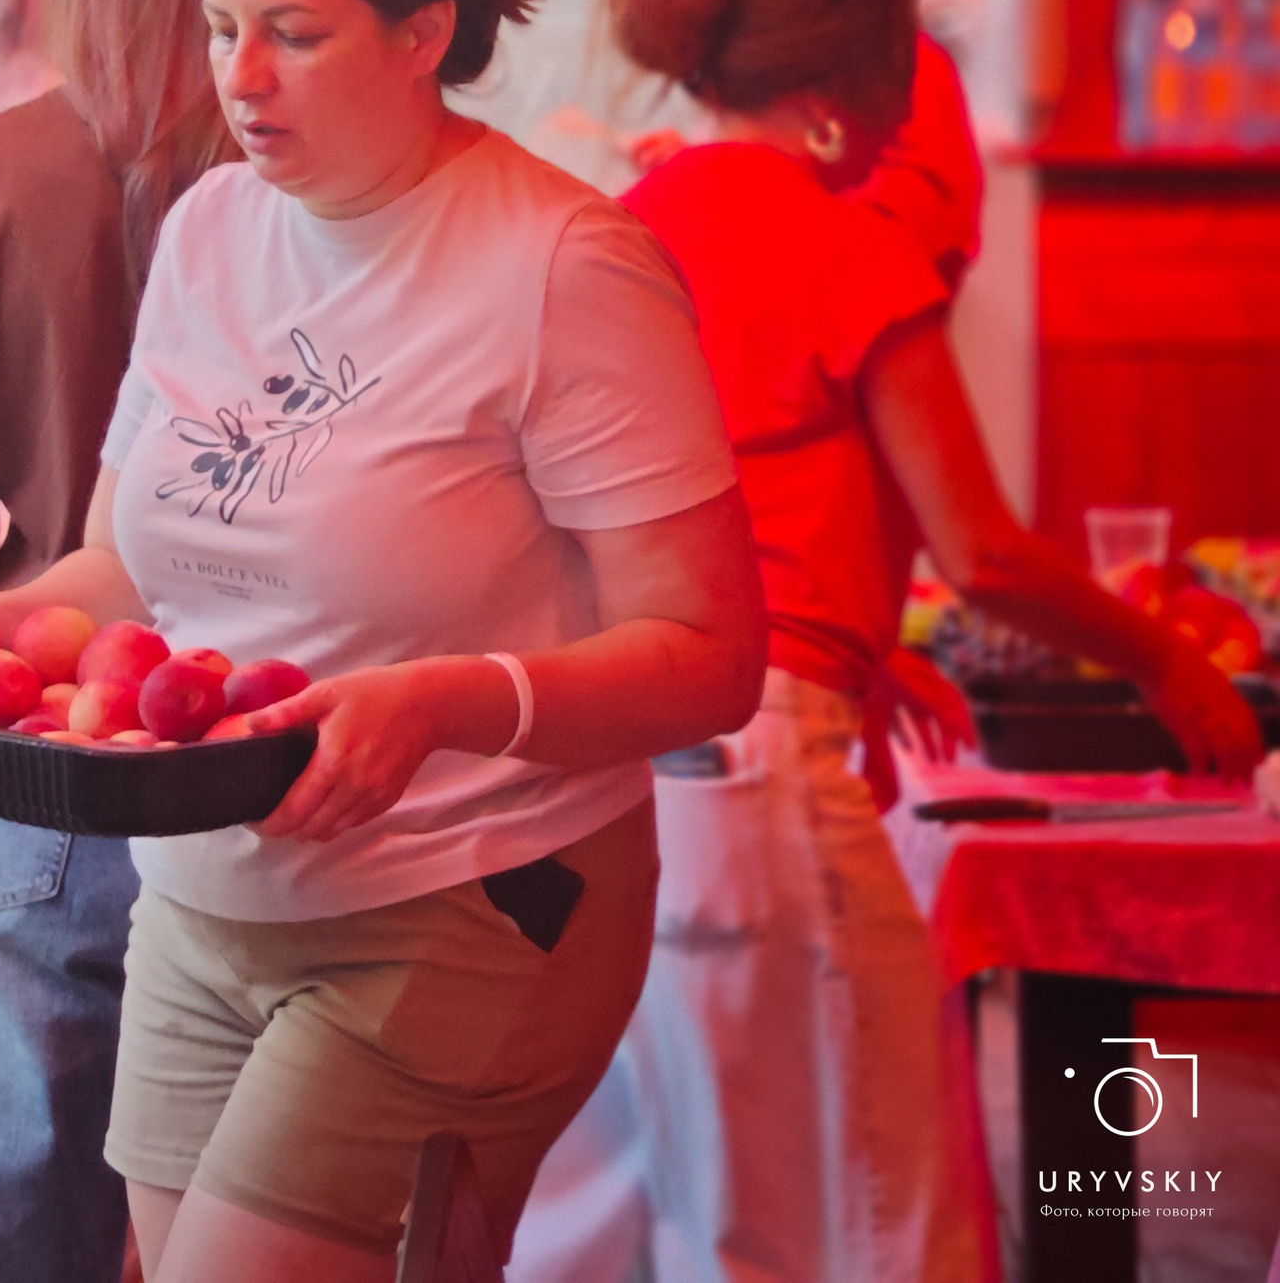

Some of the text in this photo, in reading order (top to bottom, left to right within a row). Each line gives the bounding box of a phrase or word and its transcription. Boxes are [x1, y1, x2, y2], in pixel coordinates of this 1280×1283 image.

[171, 557, 192, 571] LA
[197, 562, 248, 581] DOLCE
[254, 572, 290, 590] VITA
